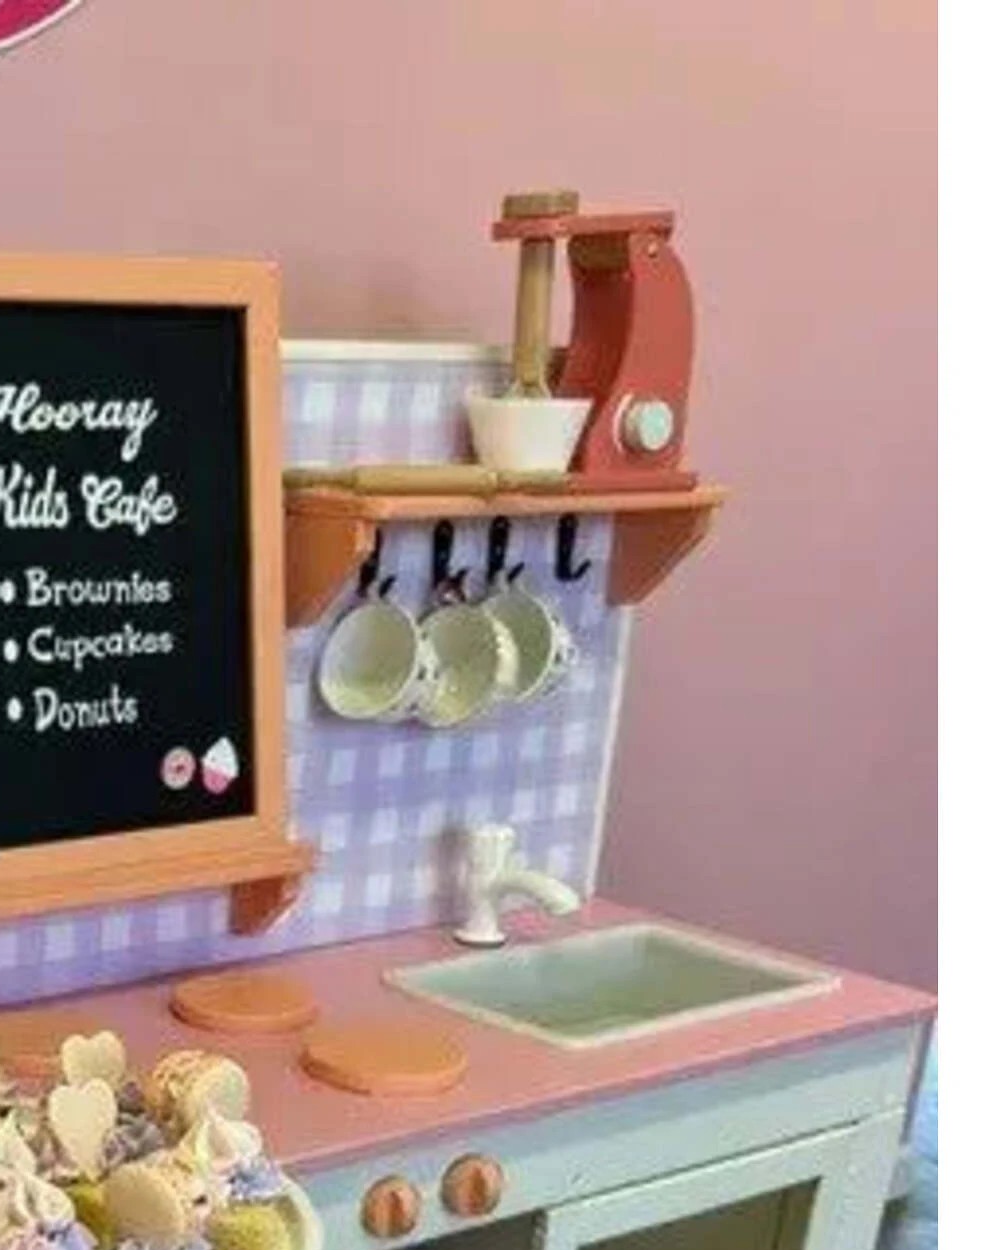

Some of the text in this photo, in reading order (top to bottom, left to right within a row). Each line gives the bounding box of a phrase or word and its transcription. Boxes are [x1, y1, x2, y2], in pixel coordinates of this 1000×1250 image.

[78, 473, 178, 537] Cafe
[23, 566, 173, 608] Brownies
[26, 622, 175, 672] Cupcakes
[31, 683, 139, 733] Donuts
